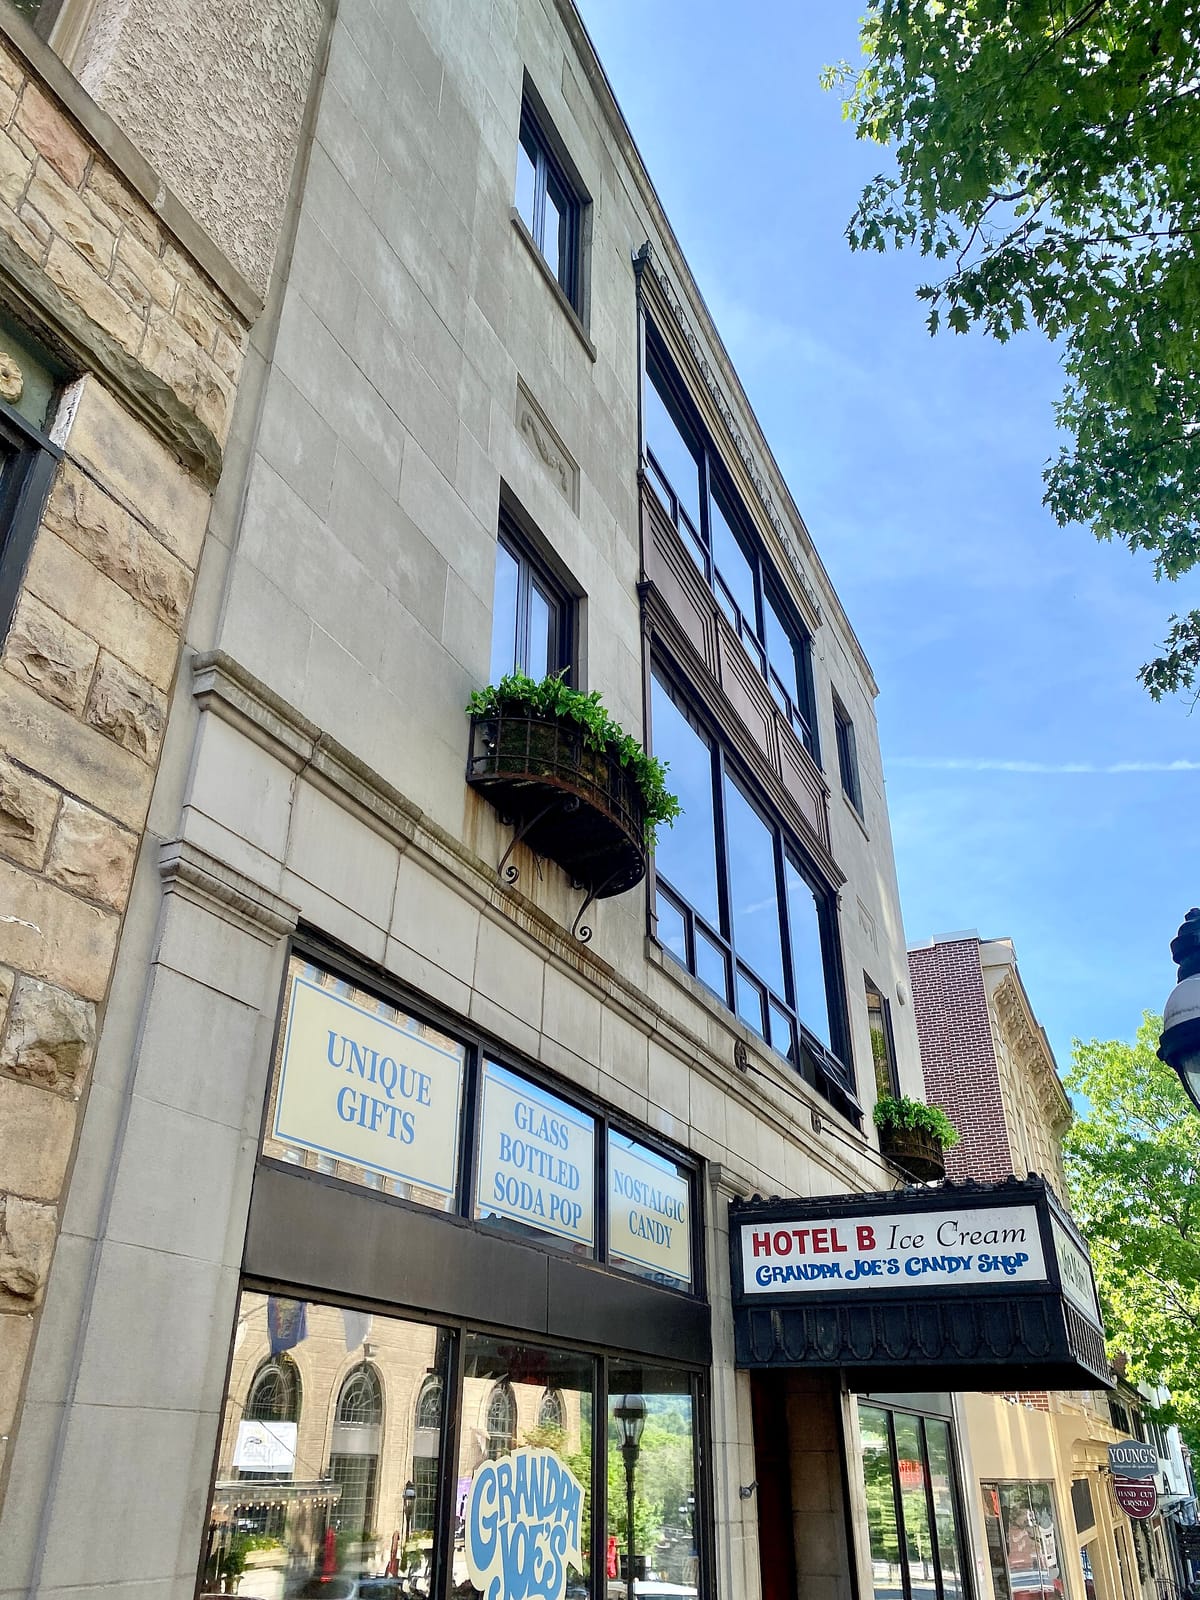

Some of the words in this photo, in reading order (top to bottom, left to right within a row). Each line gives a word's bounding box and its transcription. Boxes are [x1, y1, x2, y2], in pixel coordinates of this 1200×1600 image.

[327, 1030, 432, 1107] UNIQUE
[336, 1086, 415, 1145] GIFTS
[514, 1102, 569, 1151] GLASS
[499, 1132, 580, 1192] BOTTLED
[493, 1172, 545, 1219] SODA
[549, 1193, 583, 1230] POP
[613, 1168, 686, 1225] NOSTALGIC
[628, 1210, 673, 1250] CANDY
[752, 1226, 848, 1257] HOTEL
[855, 1225, 877, 1252] B
[886, 1224, 926, 1250] Ice
[936, 1220, 1027, 1248] Cream
[755, 1262, 842, 1287] GRANDPA
[844, 1256, 901, 1281] JOE'S
[904, 1255, 973, 1277] CANDY
[977, 1252, 1030, 1276] SHOP
[1109, 1448, 1157, 1464] YOUNG'S
[470, 1454, 581, 1572] GRANDPA
[1118, 1490, 1137, 1498] HAND
[1140, 1491, 1153, 1499] CUT
[1123, 1500, 1151, 1508] CRYSTAL
[488, 1520, 567, 1600] JOE'S
